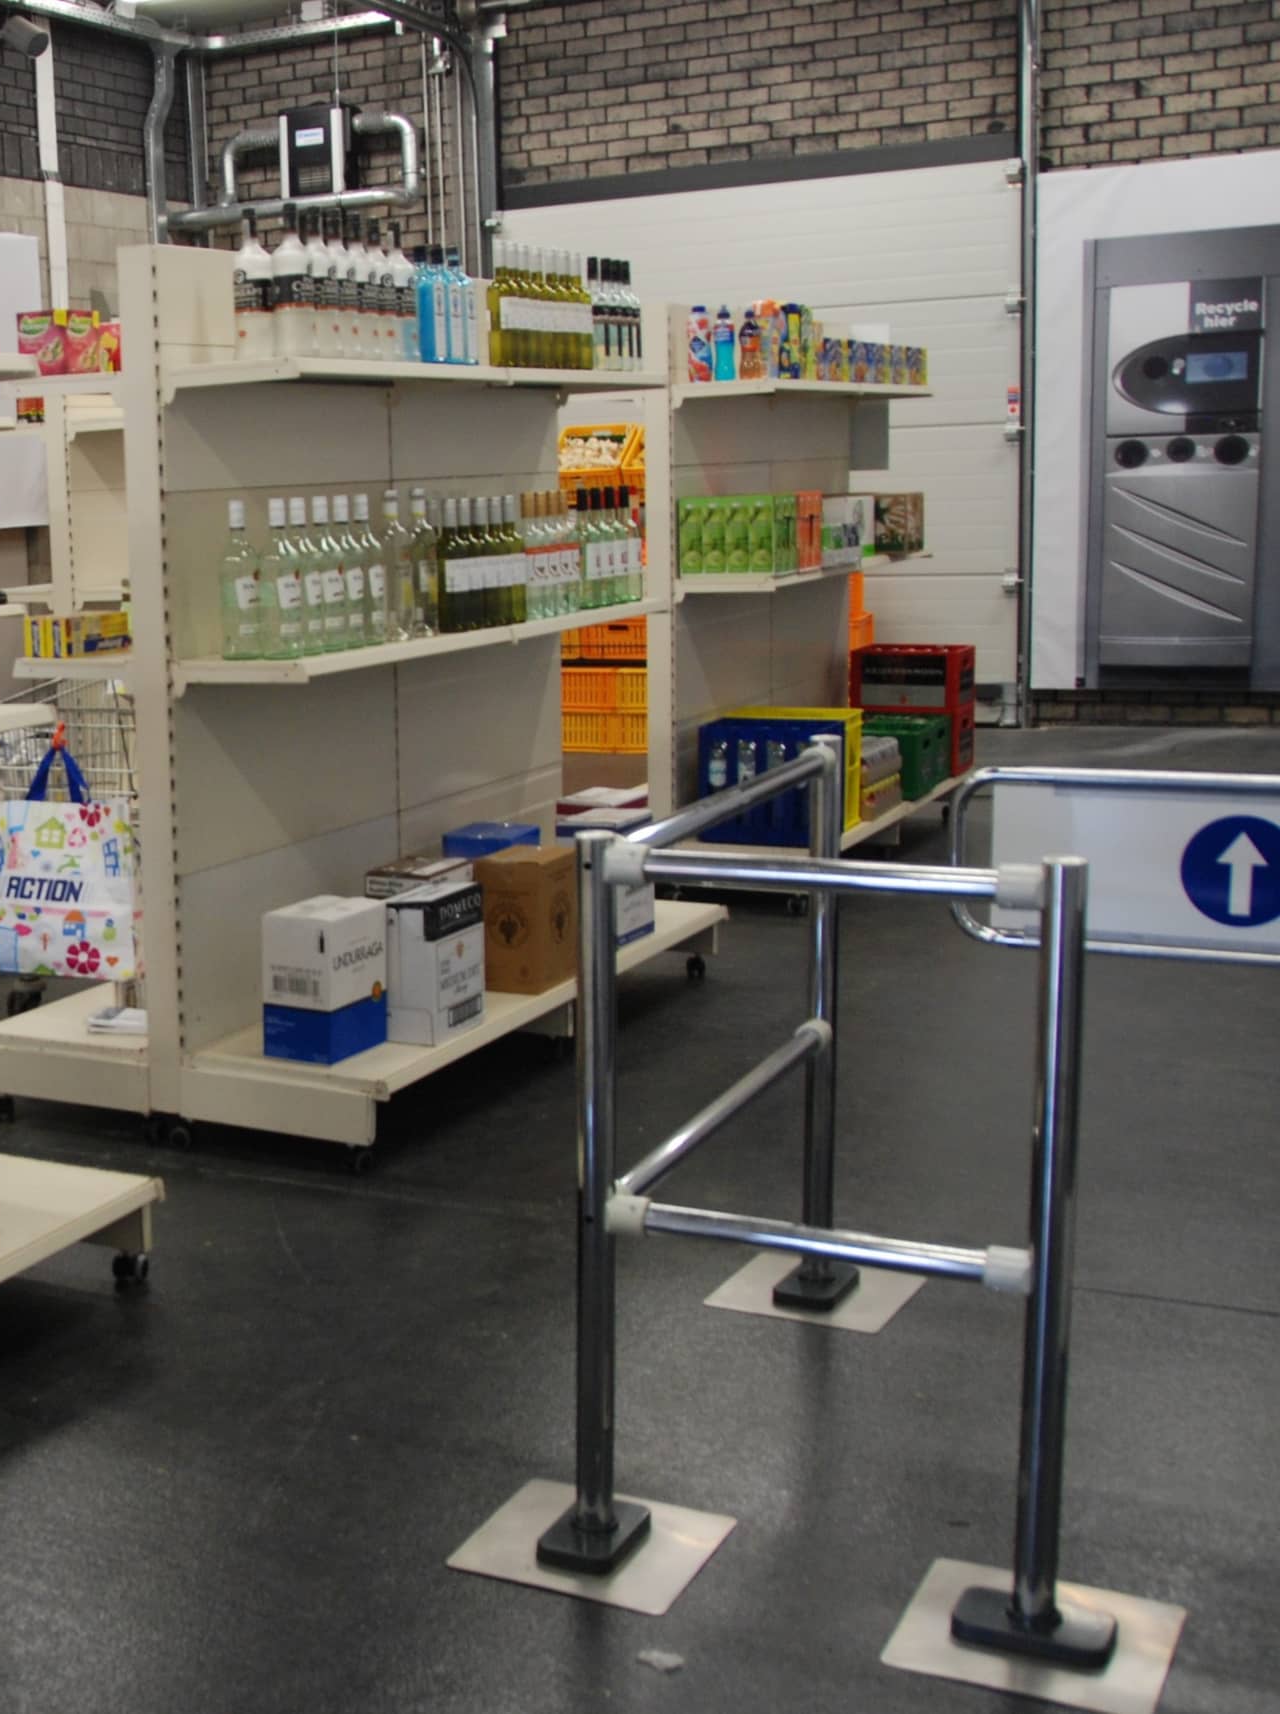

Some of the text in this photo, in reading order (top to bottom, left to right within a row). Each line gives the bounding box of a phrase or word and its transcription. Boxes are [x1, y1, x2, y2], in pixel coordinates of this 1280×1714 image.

[1195, 299, 1259, 316] Recycle
[1203, 314, 1236, 328] hier
[5, 875, 83, 903] ACTION
